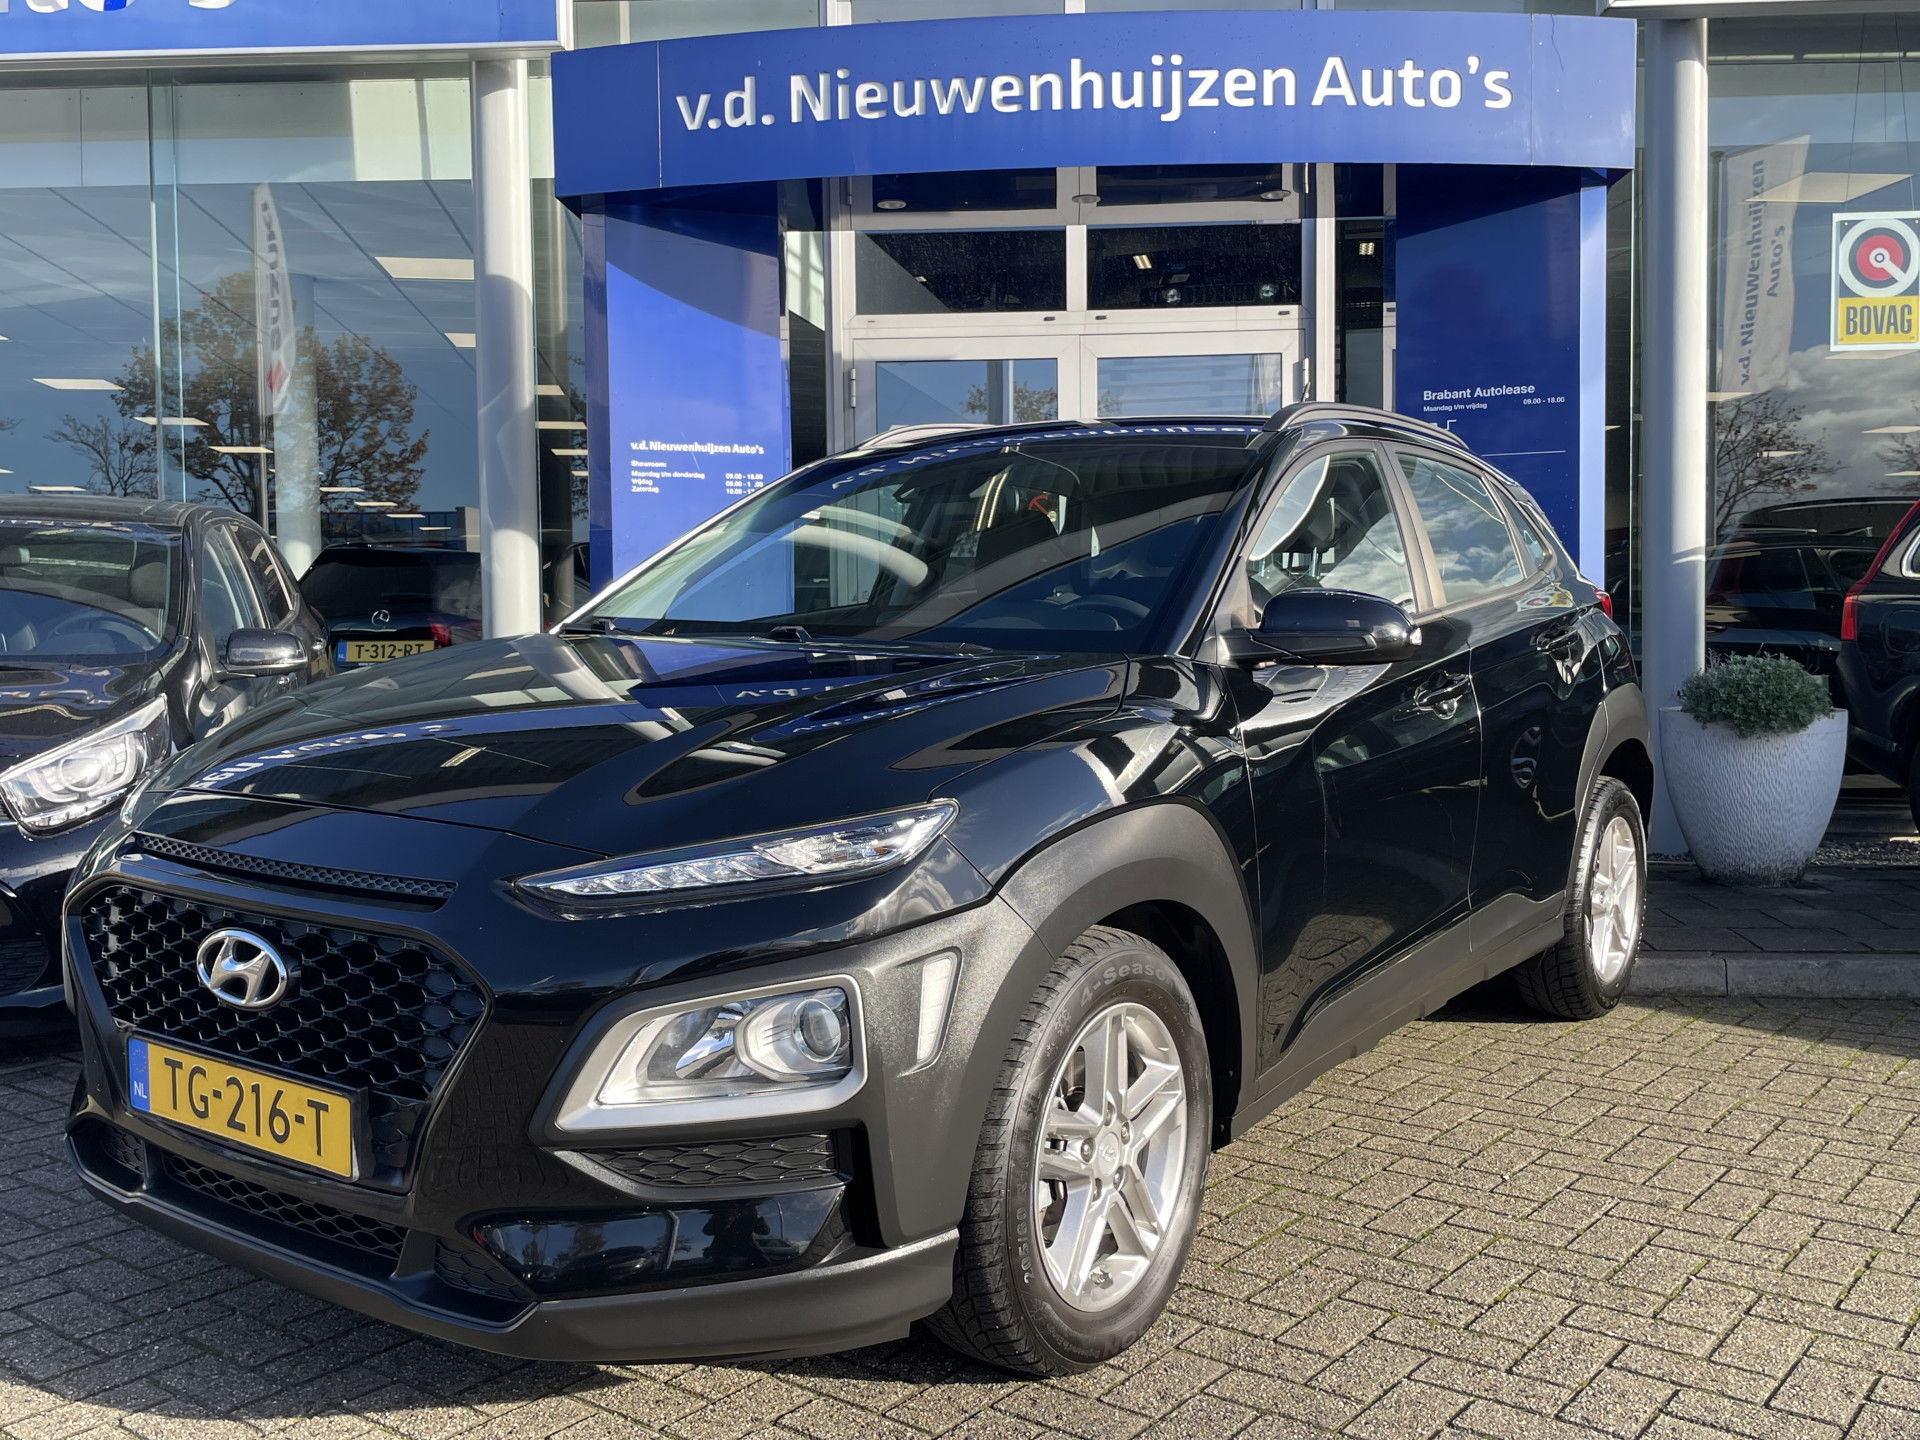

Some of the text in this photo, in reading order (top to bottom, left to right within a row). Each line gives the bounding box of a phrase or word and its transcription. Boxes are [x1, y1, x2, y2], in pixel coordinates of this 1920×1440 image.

[676, 53, 1513, 131] v.d. Nieuwenhuijzen Auto's
[1767, 225, 1785, 297] Auto's
[1845, 303, 1913, 336] BOVAG
[1739, 347, 1752, 386] v.d.
[1423, 384, 1535, 401] Brabant Autolease
[1423, 404, 1453, 412] Maandag
[631, 441, 764, 454] v.d. Nieuwenhuijzen Auto's
[630, 470, 661, 479] Maandag
[672, 471, 706, 480] donderdag
[355, 643, 425, 659] T-312-RT
[133, 1081, 148, 1099] NL
[163, 1057, 330, 1157] TG-216-T
